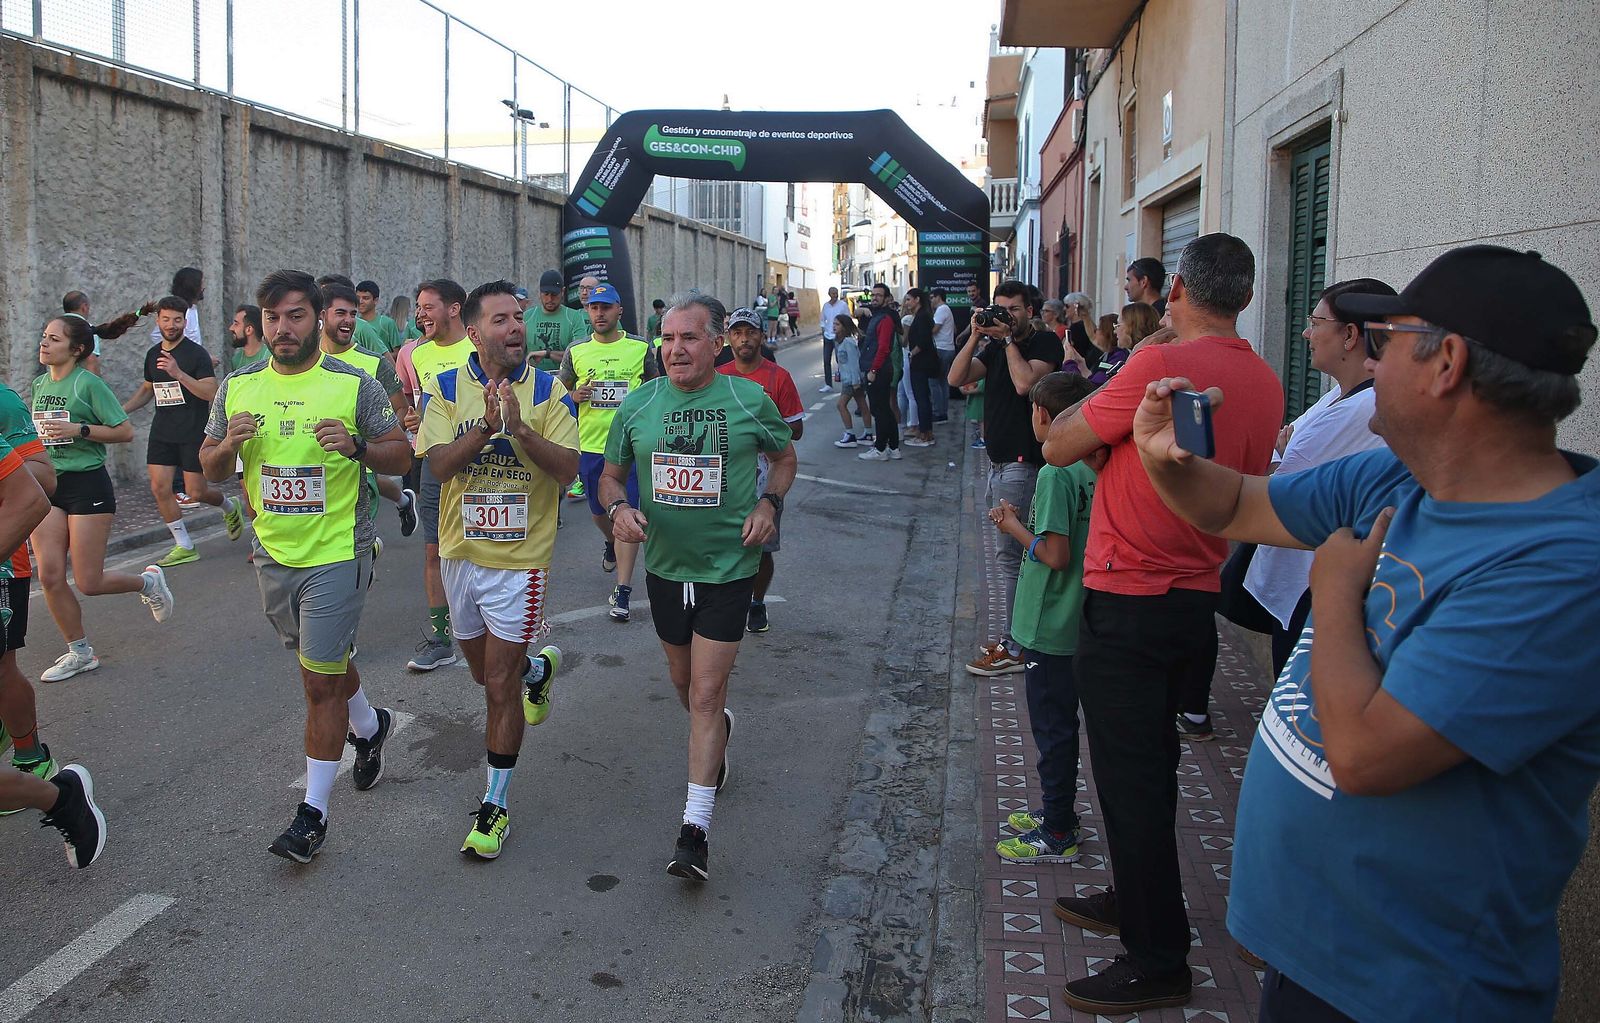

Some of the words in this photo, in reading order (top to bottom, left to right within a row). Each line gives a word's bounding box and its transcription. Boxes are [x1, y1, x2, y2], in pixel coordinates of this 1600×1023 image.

[662, 126, 693, 134] Gestión
[702, 128, 755, 138] cronometraje
[808, 130, 854, 140] deportivos
[650, 142, 742, 156] GES&CON-CHIP
[162, 388, 172, 398] 31
[602, 388, 616, 400] 52
[40, 395, 67, 406] CROSS
[672, 408, 726, 423] CROSS
[665, 426, 674, 434] 16
[480, 454, 516, 466] CRUZ
[678, 457, 696, 466] CROSS
[280, 468, 297, 476] CROSS
[491, 468, 503, 478] EN
[506, 470, 532, 482] SECO
[666, 468, 704, 490] 302
[271, 479, 307, 500] 333
[486, 496, 503, 504] CROSS
[476, 506, 509, 527] 301
[1283, 729, 1297, 748] THE
